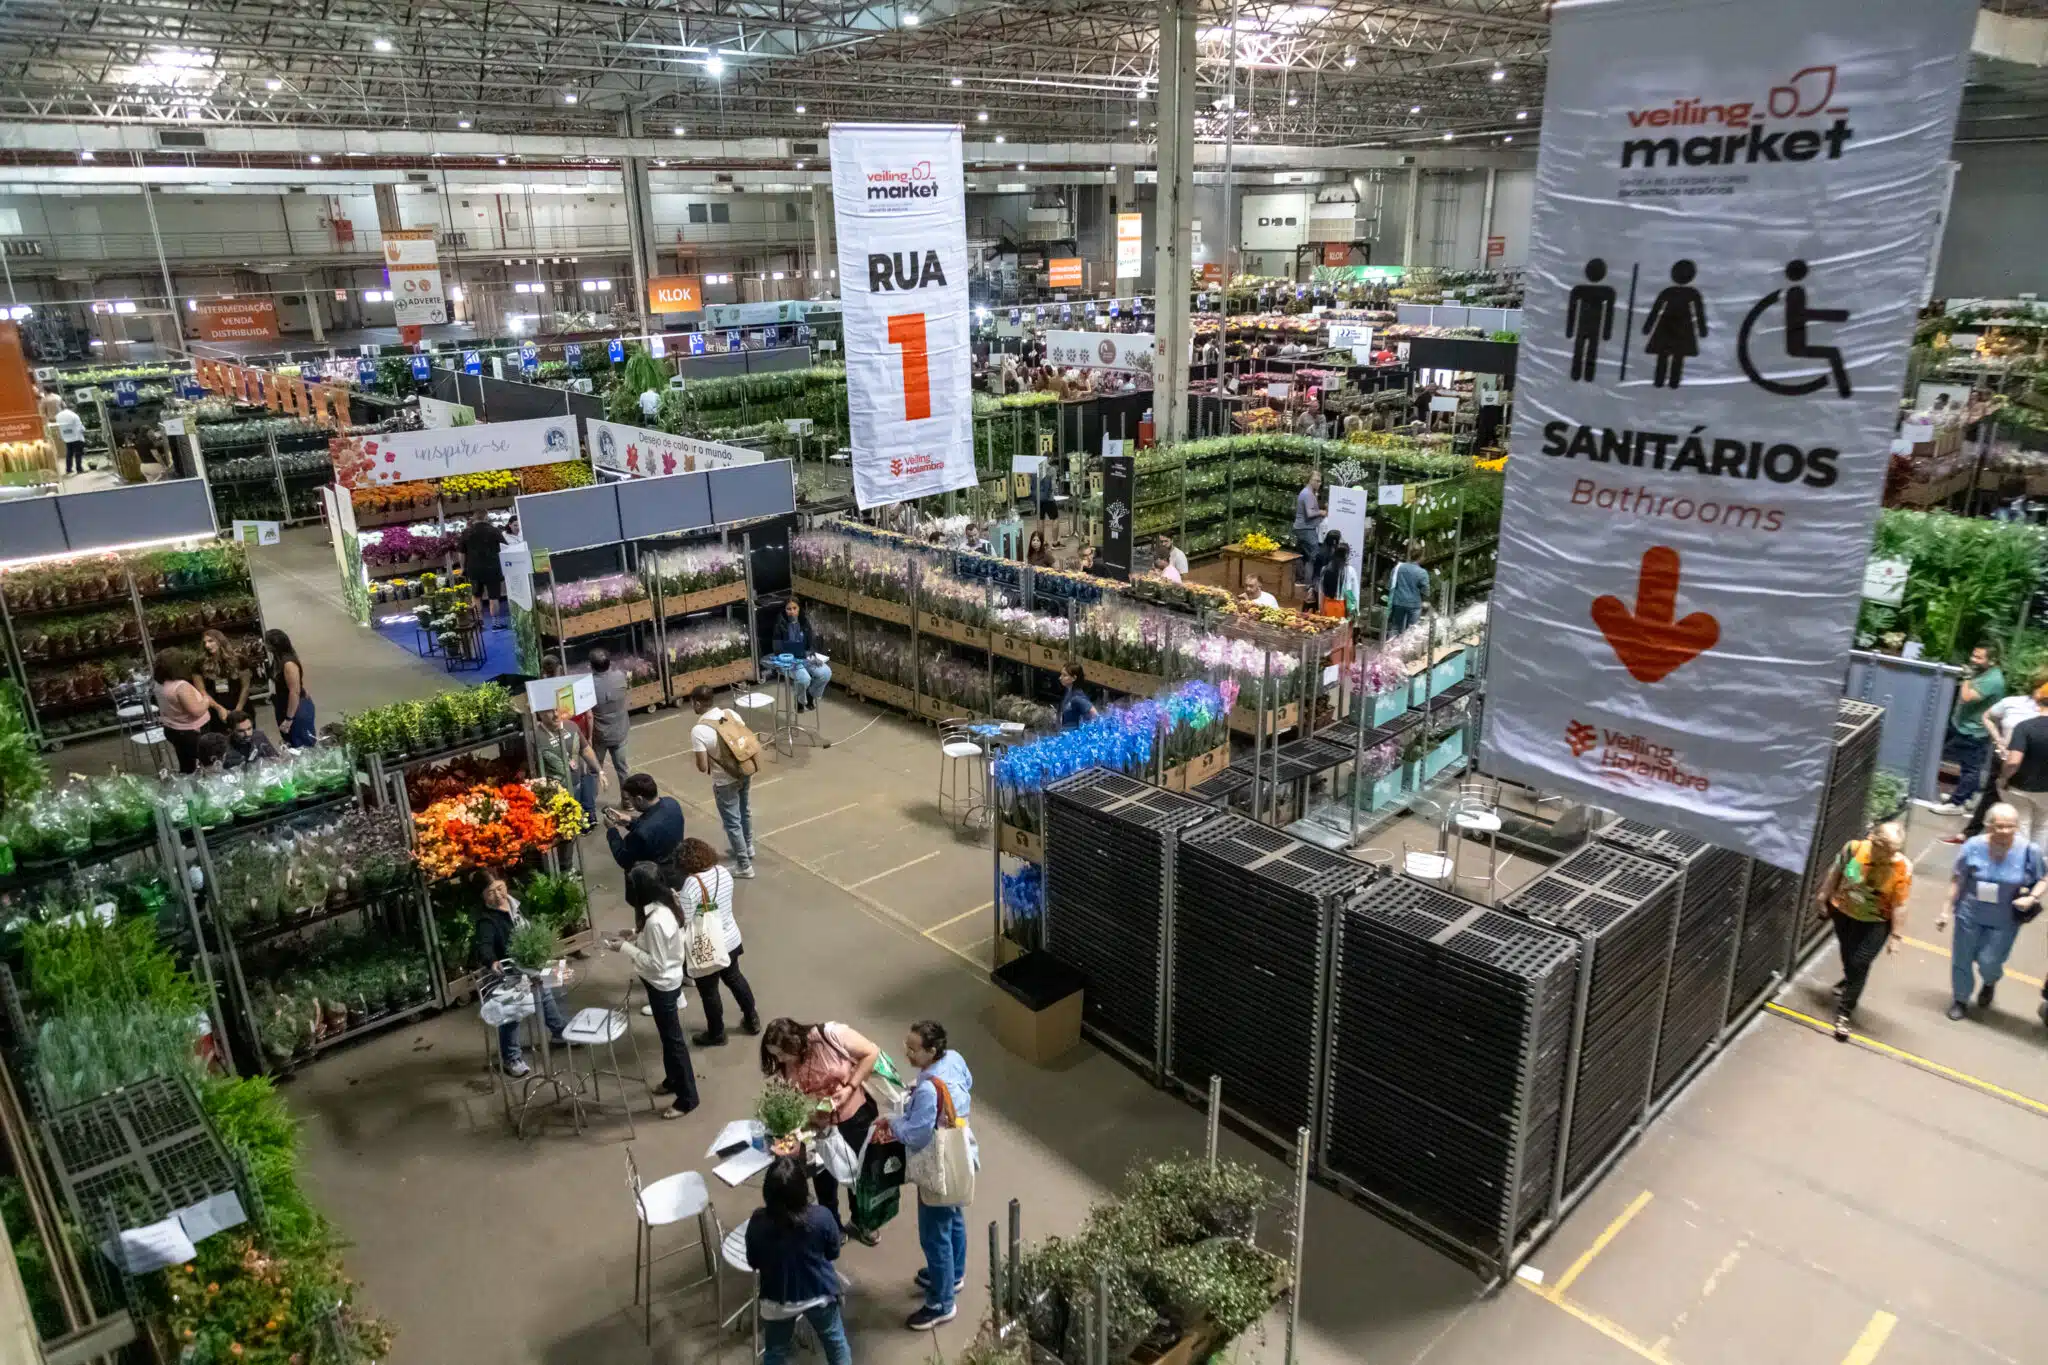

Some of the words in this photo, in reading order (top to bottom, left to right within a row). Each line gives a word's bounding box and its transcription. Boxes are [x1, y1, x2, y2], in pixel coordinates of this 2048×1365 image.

[1626, 96, 1754, 128] veiling
[1621, 119, 1854, 168] market
[866, 170, 909, 183] veiling
[867, 181, 939, 199] market
[868, 250, 947, 293] RUA
[658, 287, 692, 303] KLOK
[197, 302, 273, 315] INTERMEDIAÇÃO
[221, 316, 254, 325] VENDA
[211, 327, 270, 338] DISTRIBUIDA
[728, 331, 740, 341] 34
[765, 328, 776, 338] 33
[610, 340, 622, 352] 37
[691, 334, 703, 345] 35
[523, 348, 536, 360] 39
[567, 345, 581, 356] 38
[359, 361, 375, 372] 42
[413, 357, 428, 368] 41
[888, 313, 931, 421] 1
[302, 366, 318, 377] 43
[117, 381, 136, 393] 46
[182, 377, 200, 388] 45
[638, 432, 663, 448] Desejo
[662, 438, 672, 448] de
[415, 438, 510, 468] inspire-se
[1541, 420, 1839, 488] SANITÁRIOS
[904, 454, 931, 466] Veiling
[906, 460, 945, 475] Holambra
[1569, 478, 1786, 532] Bathrooms
[1603, 728, 1676, 767] Veiling
[1601, 749, 1710, 792] Holambra
